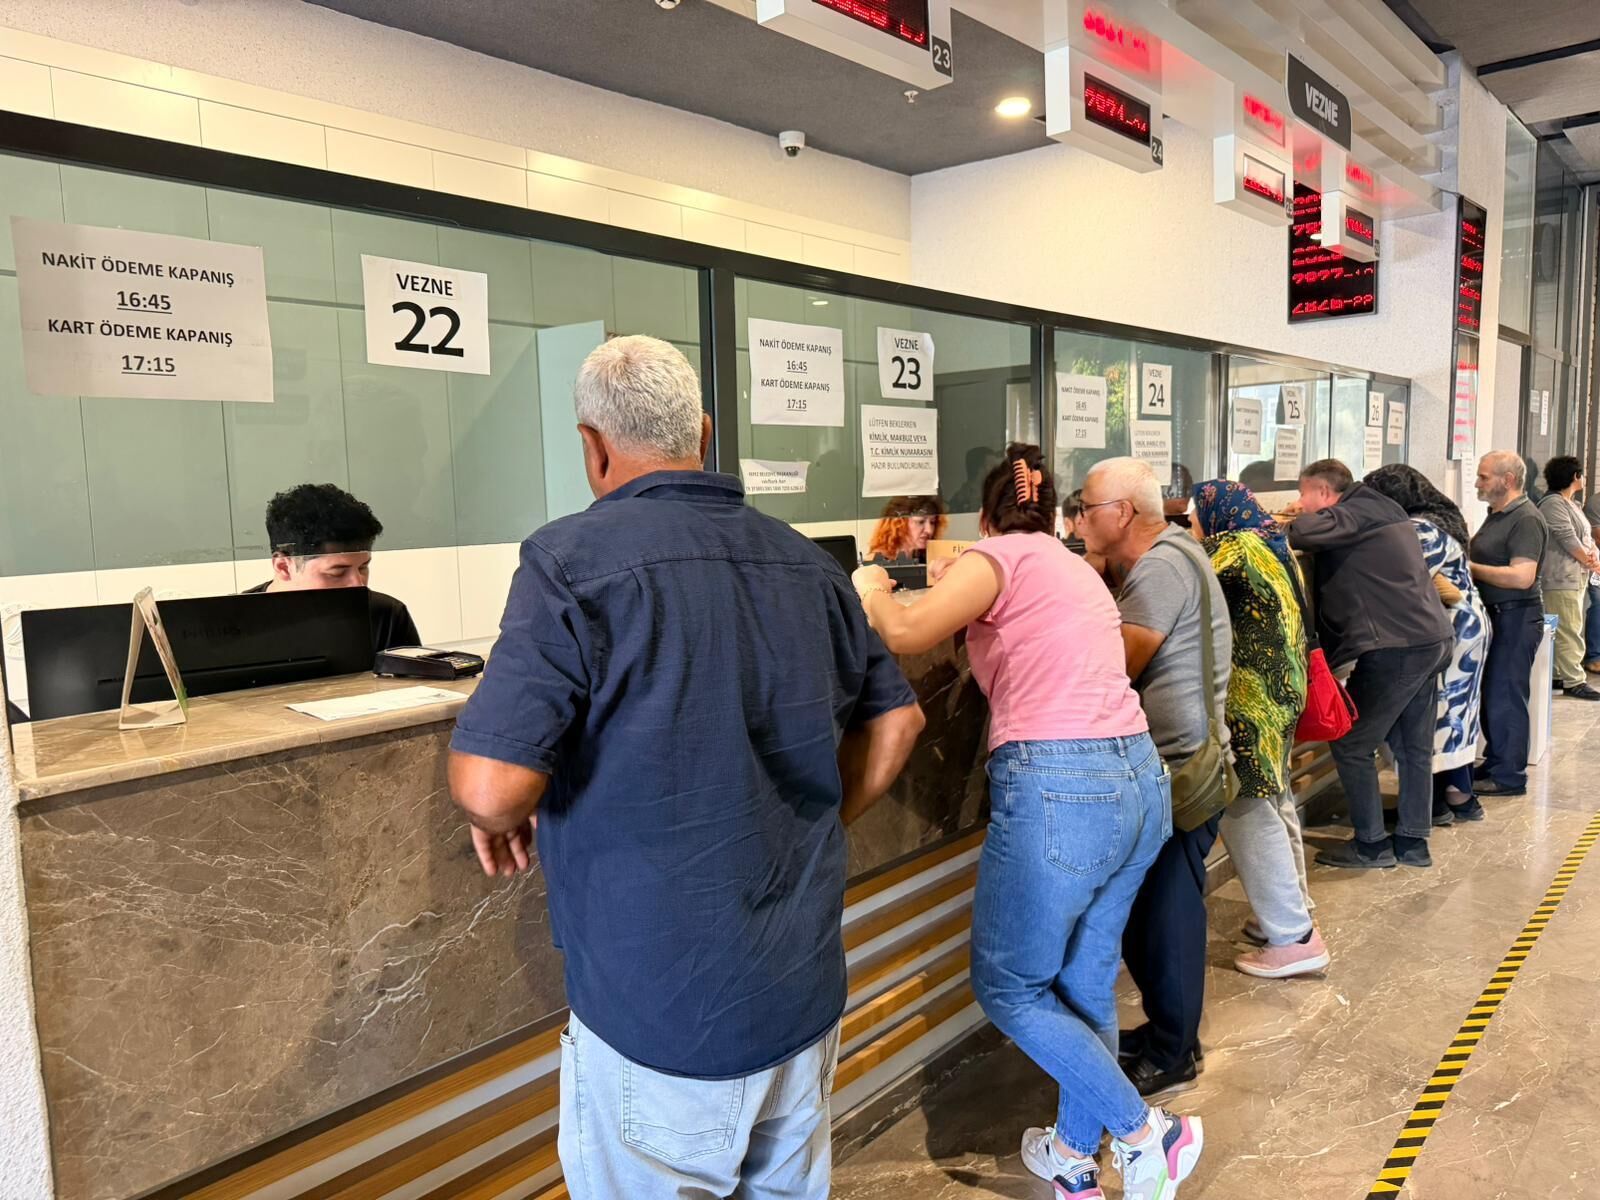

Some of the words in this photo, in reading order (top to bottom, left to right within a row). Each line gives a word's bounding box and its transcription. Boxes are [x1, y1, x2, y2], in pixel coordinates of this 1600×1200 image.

[934, 45, 950, 69] 23
[1305, 82, 1339, 127] VEZNE
[1152, 144, 1163, 160] 24
[41, 251, 97, 271] NAKİT
[101, 256, 164, 278] ÖDEME
[168, 265, 235, 287] KAPANIŞ
[396, 273, 454, 297] VEZNE
[116, 290, 172, 312] 16:45
[48, 319, 95, 335] KART
[100, 320, 162, 340] ÖDEME
[166, 327, 233, 348] KAPANIŞ
[392, 301, 464, 358] 22
[759, 338, 780, 349] NAKİT
[781, 339, 805, 352] ÖDEME
[806, 344, 832, 356] KAPANIŞ
[894, 337, 919, 351] VEZNE
[121, 355, 176, 374] 17:15
[786, 360, 808, 373] 16:45
[891, 355, 922, 390] 23
[760, 378, 778, 388] KART
[779, 377, 803, 390] ÖDEME
[804, 383, 830, 394] KAPANIŞ
[1148, 382, 1165, 408] 24
[787, 399, 807, 410] 17:15
[1287, 400, 1301, 419] 25
